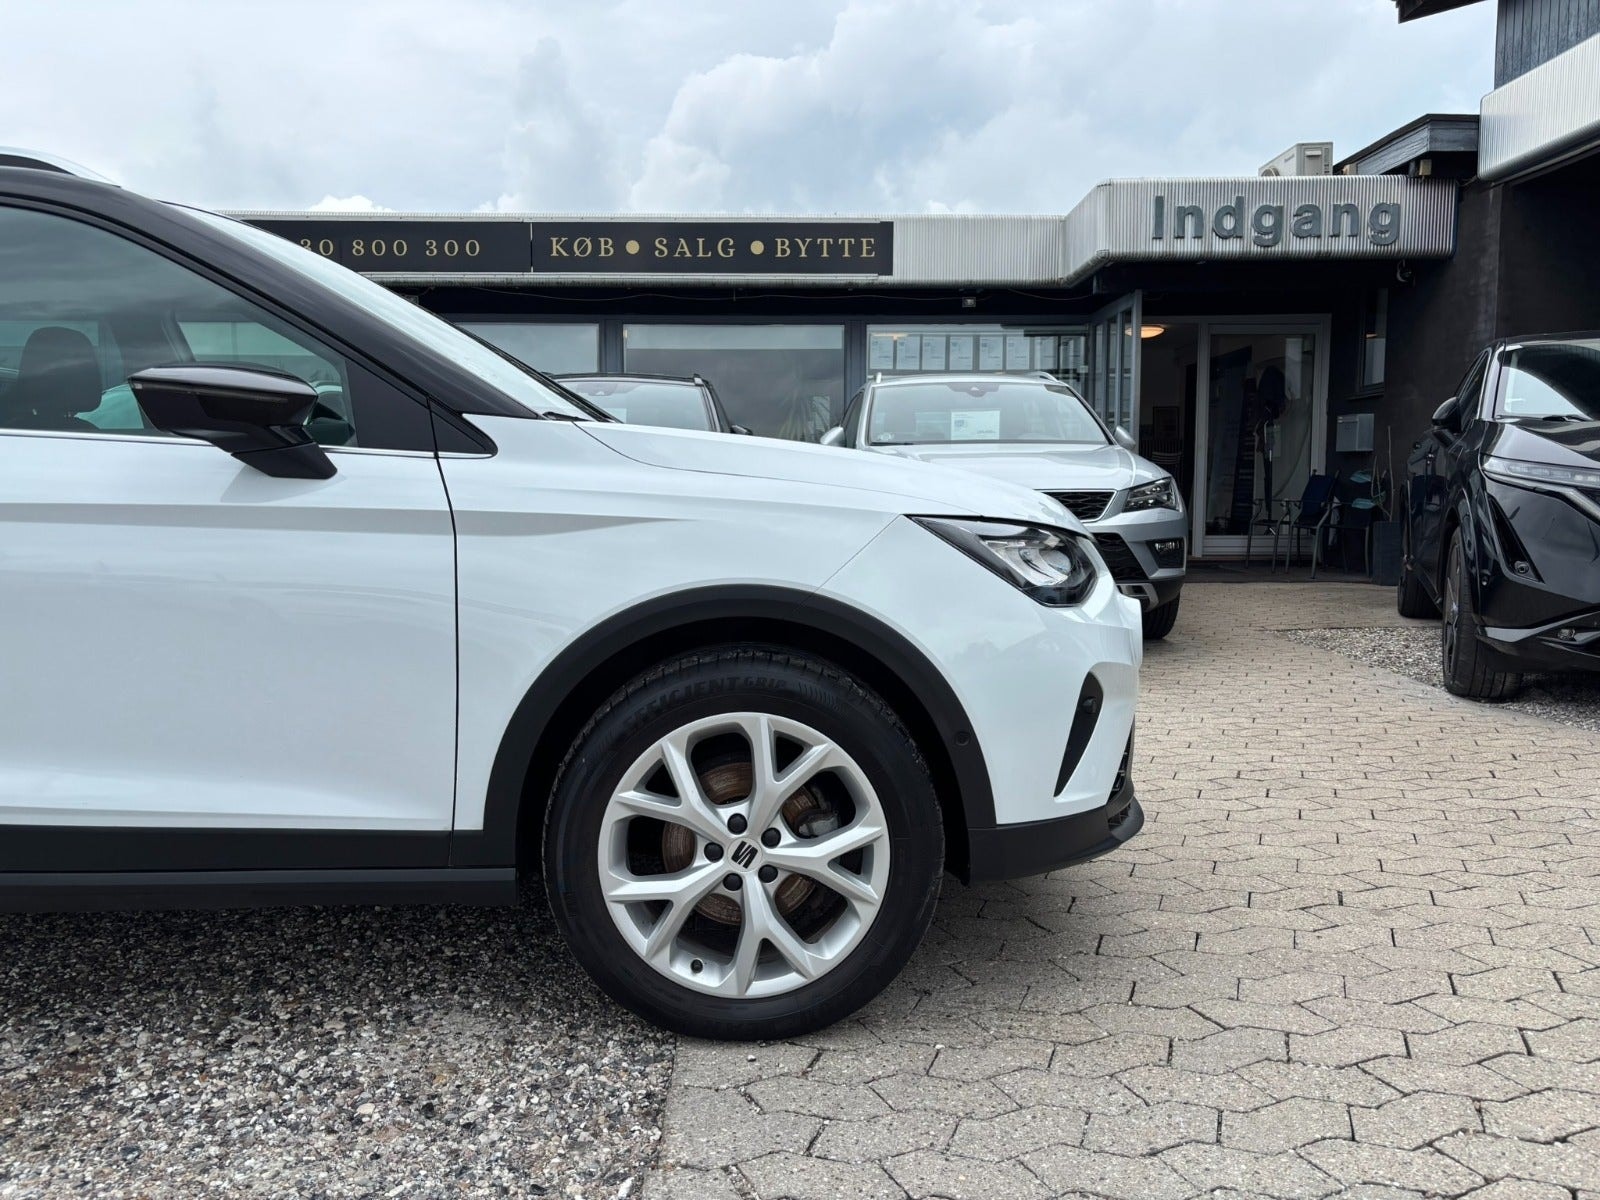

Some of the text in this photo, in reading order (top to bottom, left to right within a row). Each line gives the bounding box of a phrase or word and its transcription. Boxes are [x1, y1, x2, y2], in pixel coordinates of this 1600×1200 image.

[1152, 195, 1400, 247] Indgang
[352, 239, 408, 257] 800
[425, 239, 481, 257] 300
[549, 236, 877, 258] KØB SALG BYTTE
